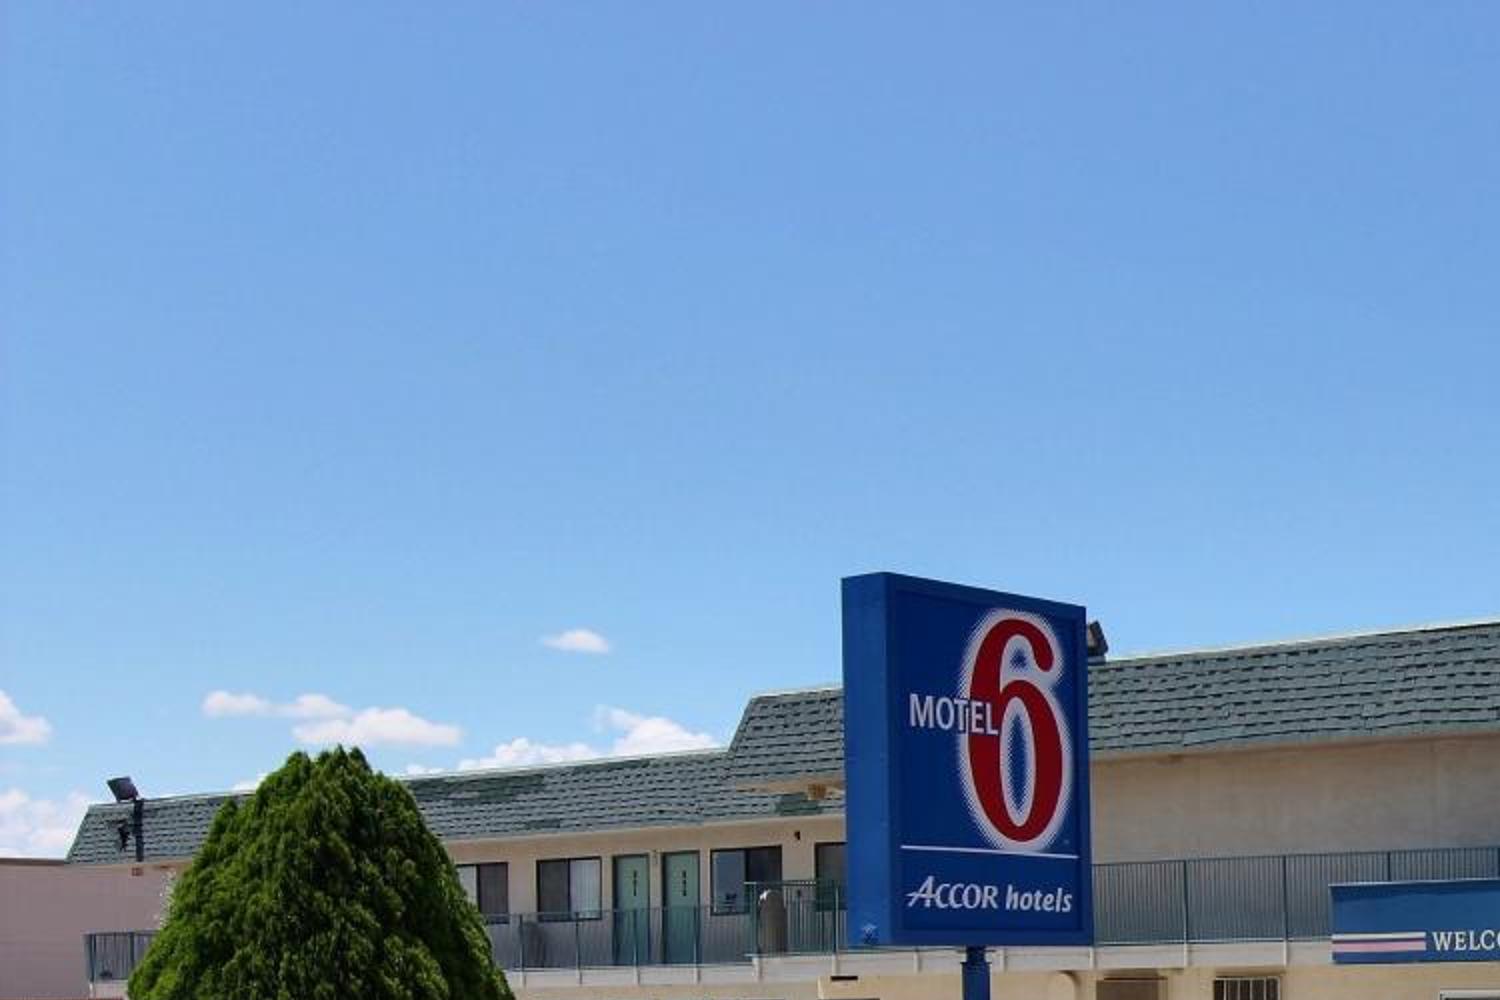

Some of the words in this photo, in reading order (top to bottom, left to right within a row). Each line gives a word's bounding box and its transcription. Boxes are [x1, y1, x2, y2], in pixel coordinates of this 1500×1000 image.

[909, 693, 999, 735] MOTEL
[967, 617, 1064, 843] 6
[1005, 884, 1073, 913] hotels
